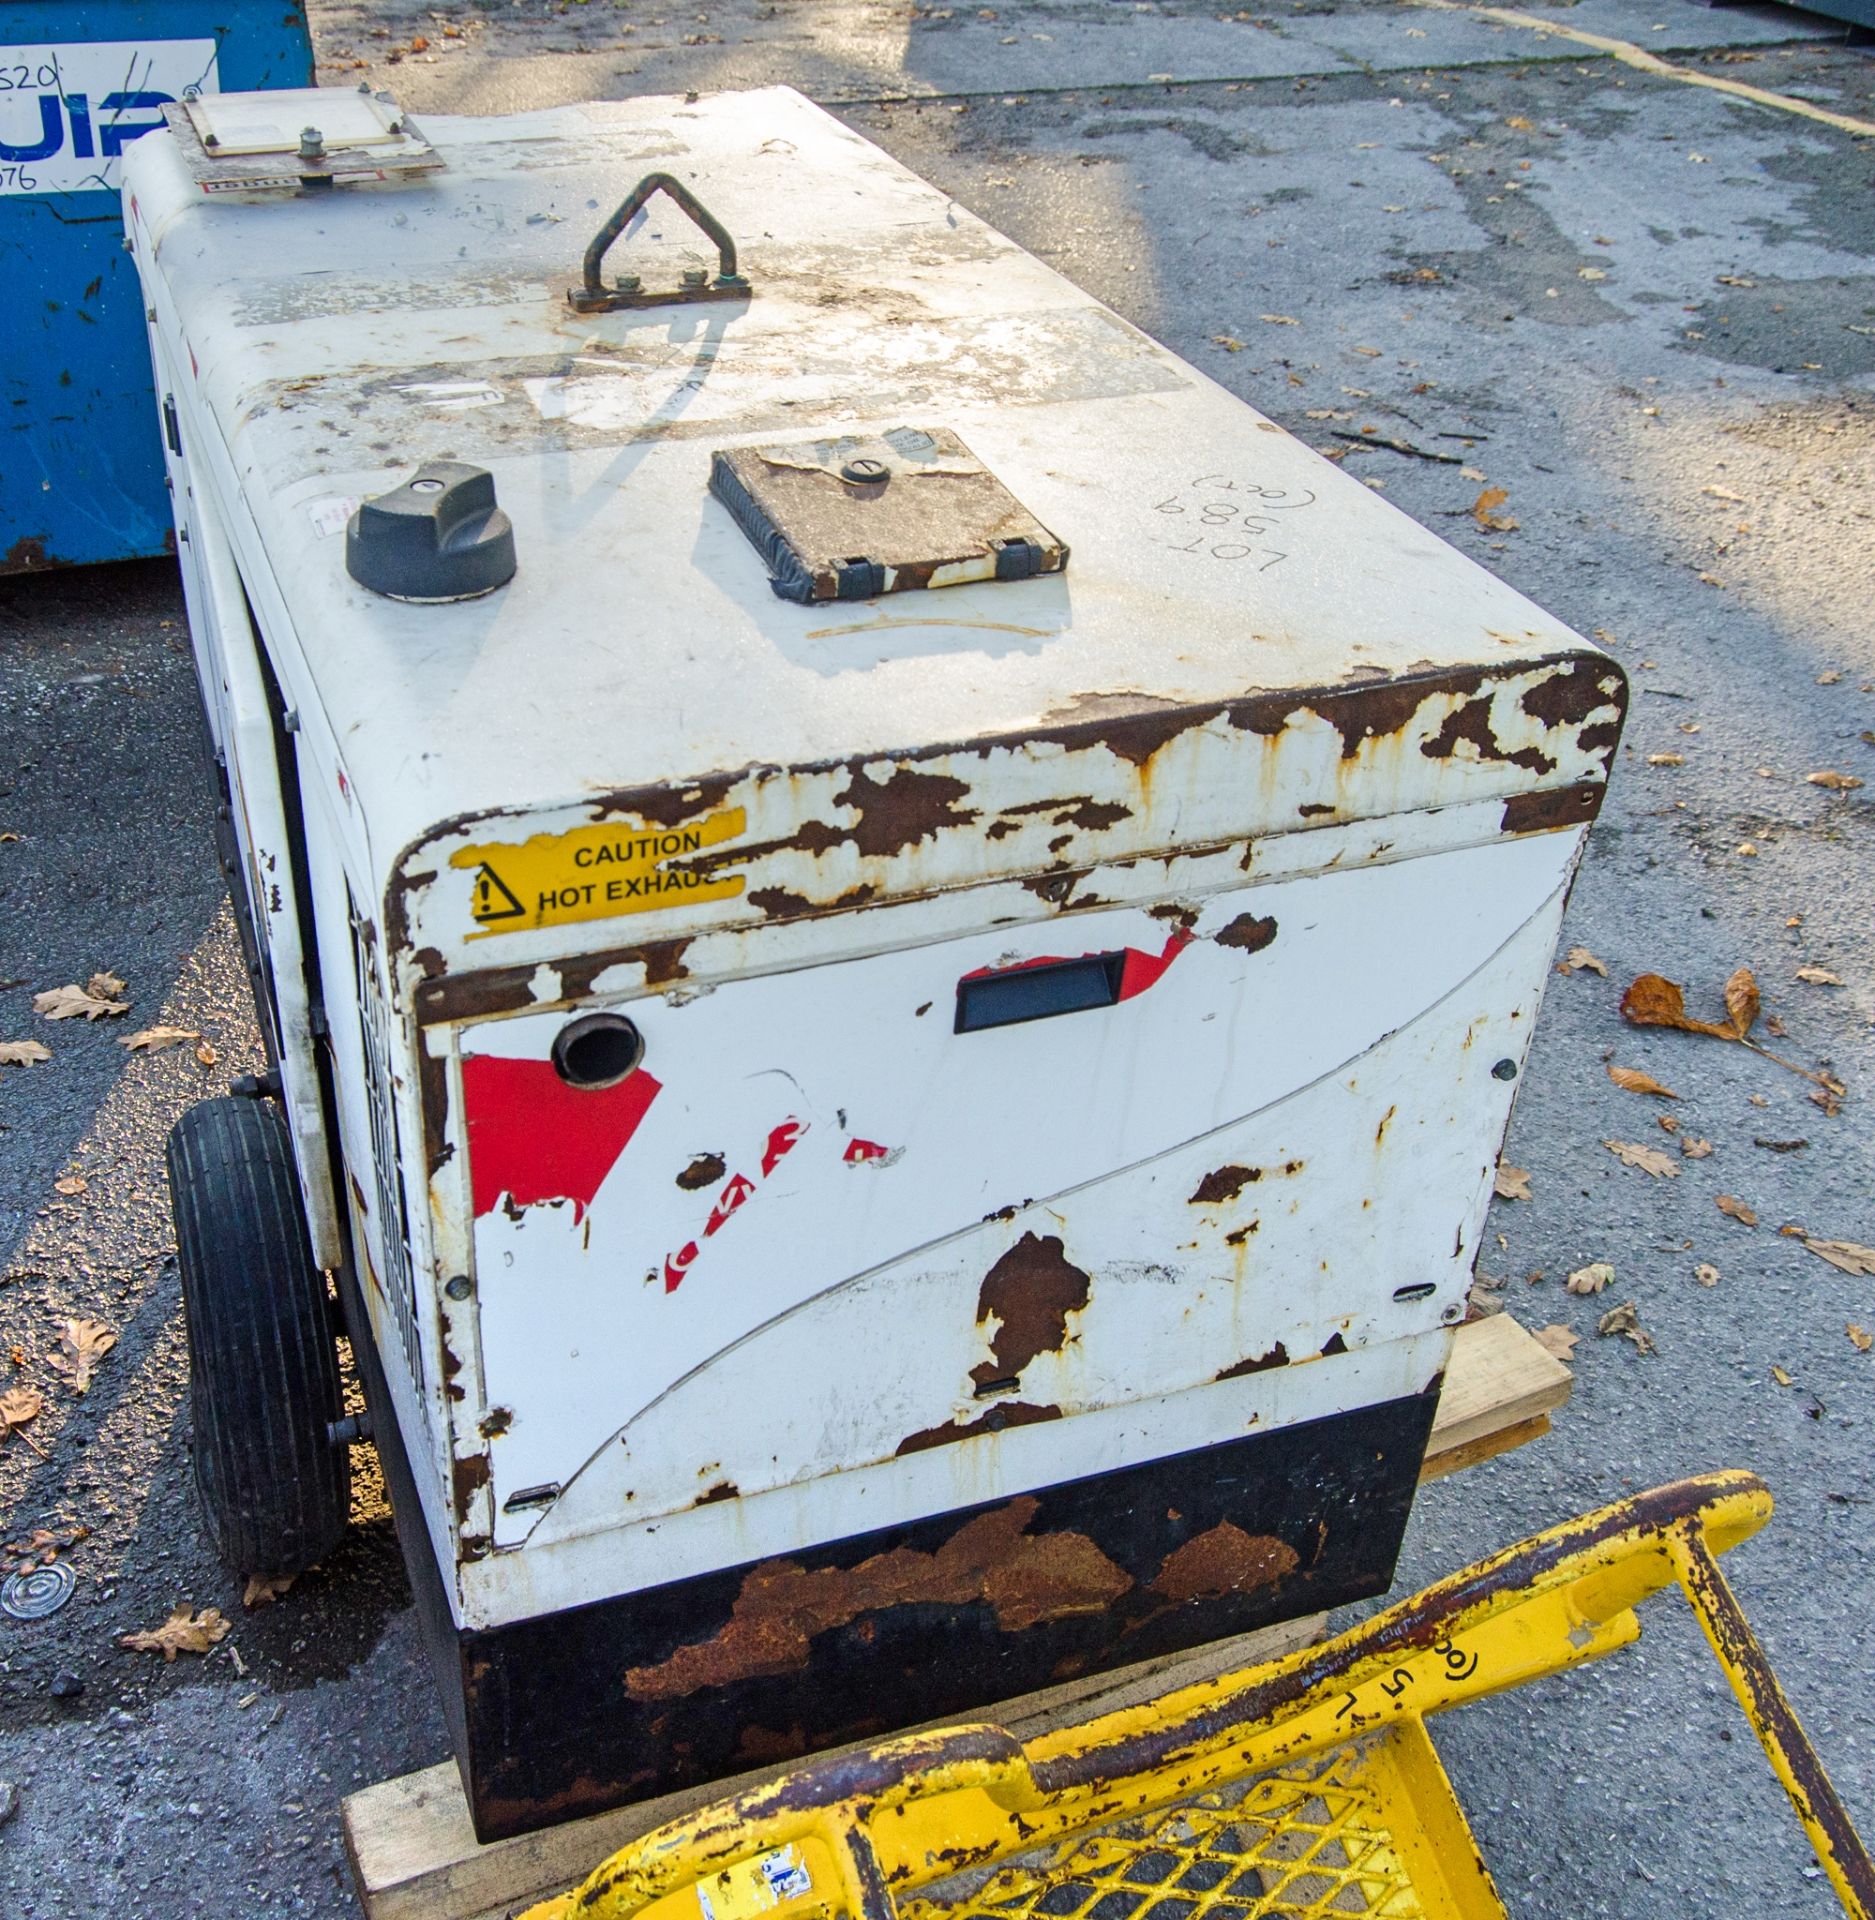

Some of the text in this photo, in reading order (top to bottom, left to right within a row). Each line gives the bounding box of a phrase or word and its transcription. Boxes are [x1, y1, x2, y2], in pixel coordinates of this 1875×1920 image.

[0, 165, 37, 190] 76
[1154, 496, 1281, 534] 589
[1167, 537, 1288, 571] LOT
[574, 831, 700, 868] CAUTION
[538, 868, 733, 911] HOT EXHAU
